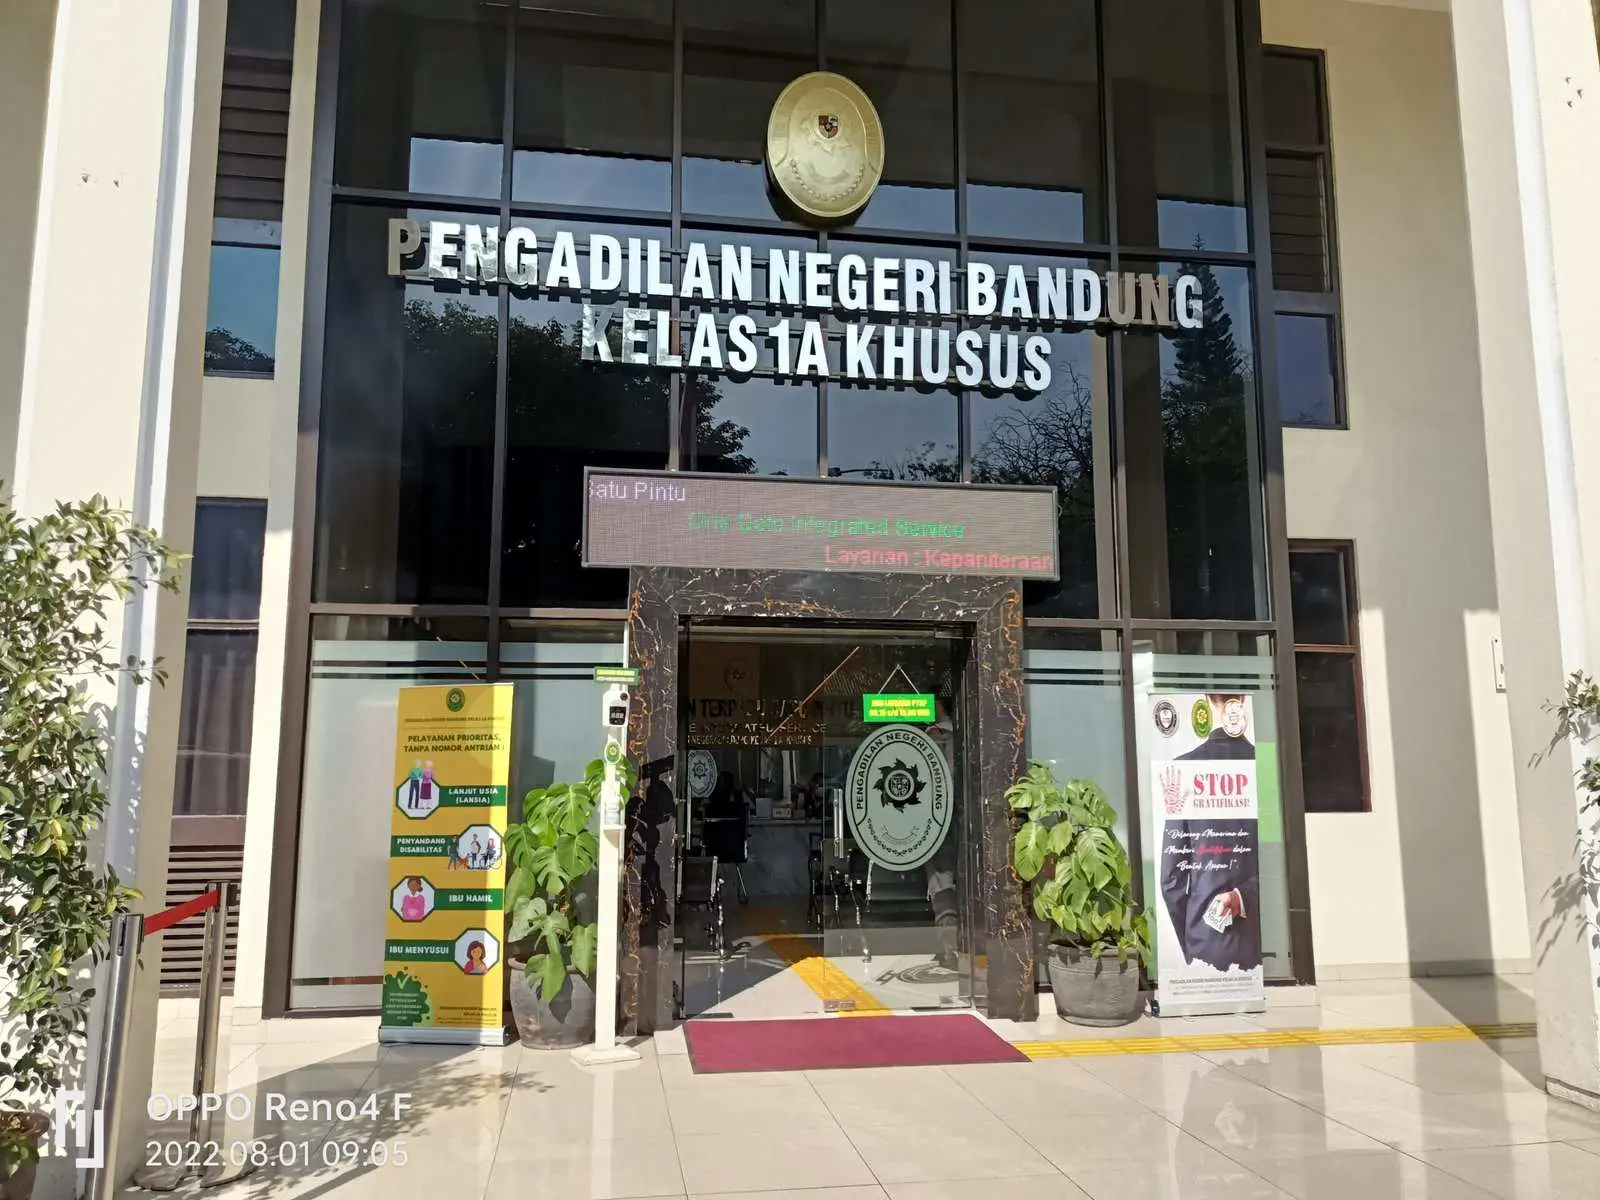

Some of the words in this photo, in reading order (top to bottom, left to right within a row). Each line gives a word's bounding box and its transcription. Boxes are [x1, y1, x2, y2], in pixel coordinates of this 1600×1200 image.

[388, 218, 752, 302] PENGADILAN
[769, 248, 953, 315] NEGERI
[967, 262, 1204, 329] BANDUNG
[581, 303, 758, 374] KELAS
[768, 319, 830, 377] 1A
[845, 323, 1052, 392] KHUSUS
[634, 481, 685, 501] Pintu
[895, 519, 966, 540] Service
[823, 545, 908, 568] Layanan
[408, 734, 455, 743] PELAYANAN
[404, 745, 430, 753] TANPA
[431, 744, 462, 752] NOMOR
[856, 738, 883, 810] PENGADILAN
[886, 732, 929, 752] NEGERI
[927, 752, 942, 810] BANDUNG
[479, 787, 498, 795] USIA
[1193, 773, 1249, 796] STOP
[456, 796, 491, 804] (LANSIA)
[396, 837, 446, 845] PENYANDANG
[449, 894, 464, 902] IBU
[465, 894, 493, 903] HAMIL
[389, 946, 403, 954] IBU
[405, 946, 449, 955] MENYUSUI
